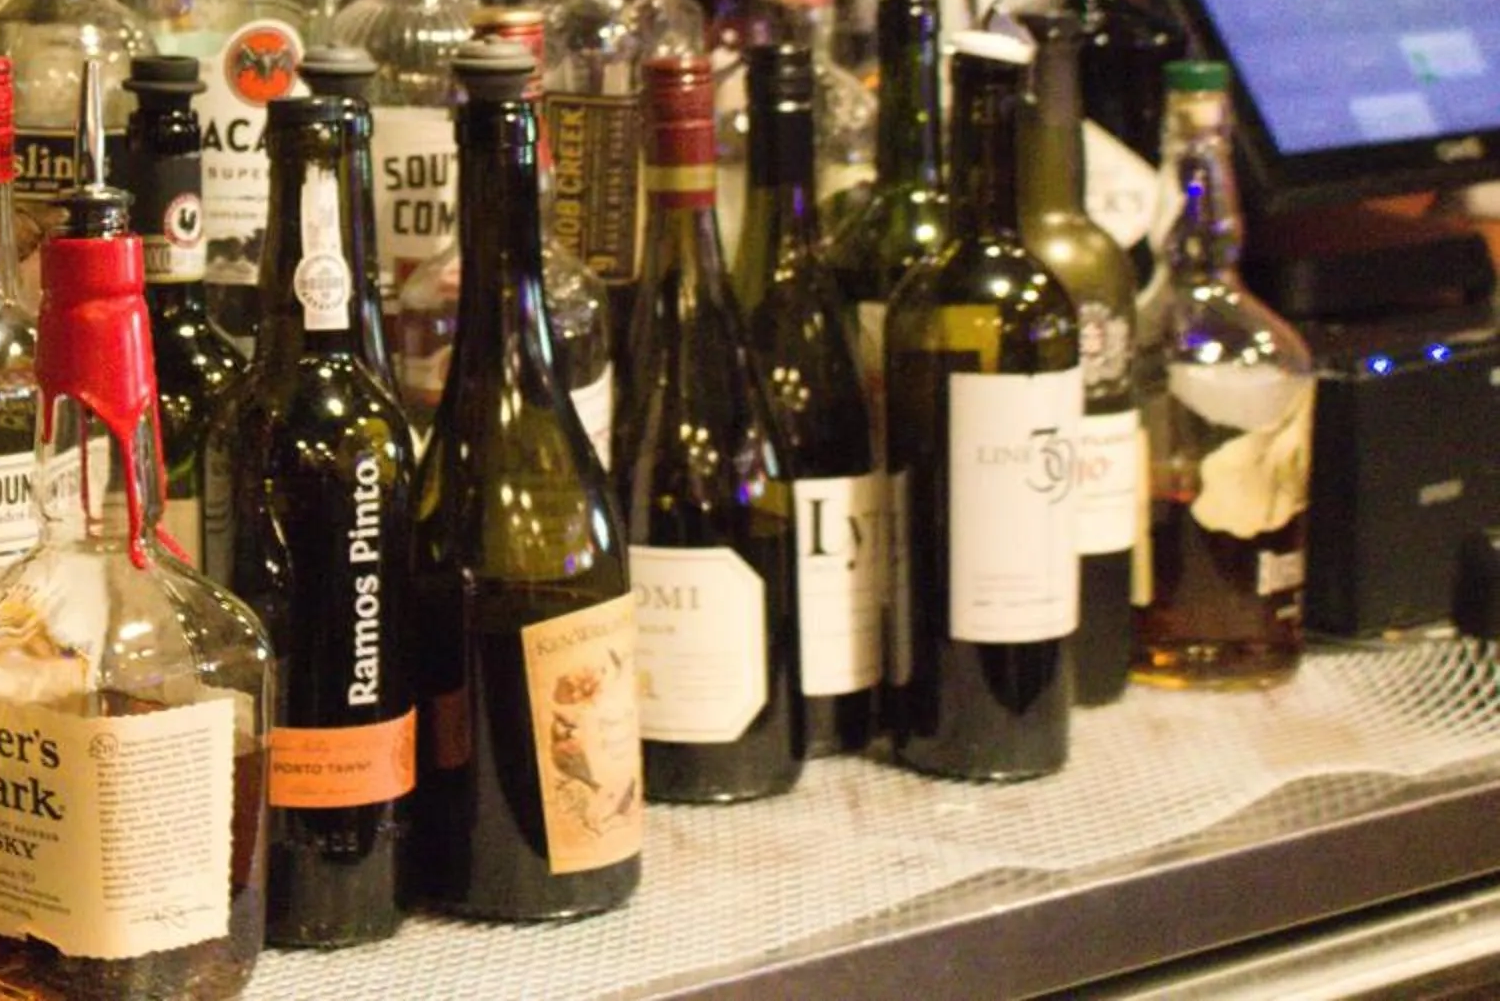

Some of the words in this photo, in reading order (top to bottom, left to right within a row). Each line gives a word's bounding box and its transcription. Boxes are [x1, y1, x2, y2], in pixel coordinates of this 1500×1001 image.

[12, 142, 74, 178] slin
[559, 106, 586, 194] CREEK
[208, 166, 260, 180] SUPE
[384, 153, 458, 191] SOU
[349, 457, 380, 563] Pinto
[636, 584, 700, 610] OMI
[348, 575, 380, 706] Ramos
[273, 761, 323, 776] PORTO
